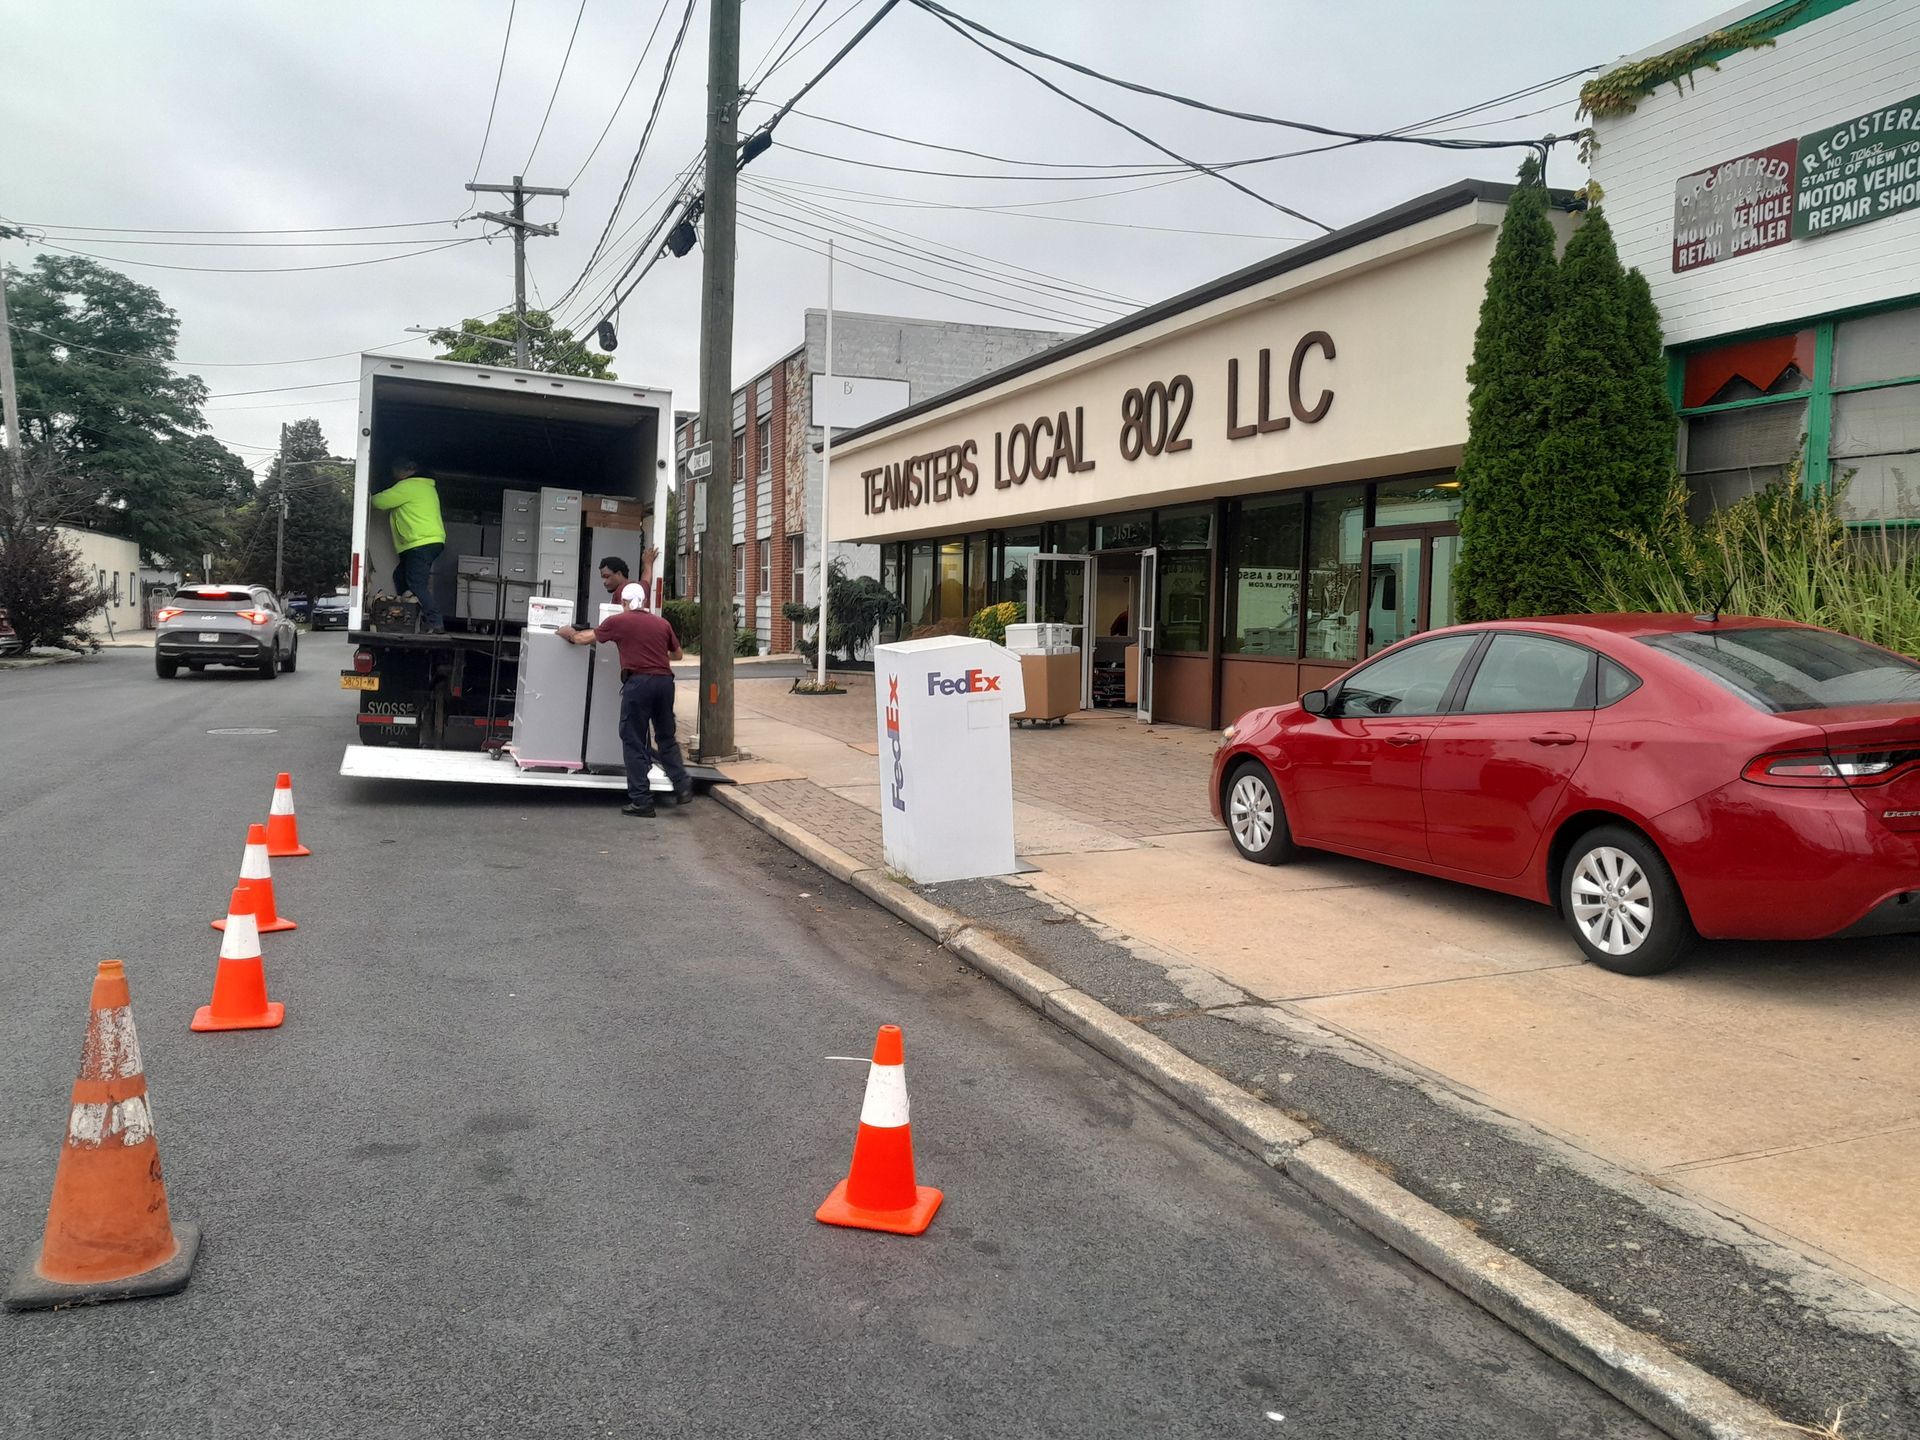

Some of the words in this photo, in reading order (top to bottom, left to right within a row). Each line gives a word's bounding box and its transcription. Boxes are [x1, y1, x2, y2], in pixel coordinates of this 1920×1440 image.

[1798, 177, 1858, 212] MOTOR
[1862, 156, 1920, 193] VEHIC
[1801, 168, 1840, 188] STATE
[1845, 161, 1863, 175] OF
[1866, 149, 1897, 169] NEW
[1758, 182, 1789, 201] YORK
[1731, 195, 1791, 231] VEHICLE
[1808, 196, 1872, 231] REPAIR
[1731, 219, 1787, 252] DEALER
[860, 438, 979, 515] TEAMSTERS
[994, 406, 1096, 490] LOCAL
[1119, 374, 1194, 462] 802
[1226, 330, 1336, 440] LLC
[694, 455, 702, 469] ONE
[927, 668, 1001, 697] FedEx
[886, 672, 906, 813] FedEx
